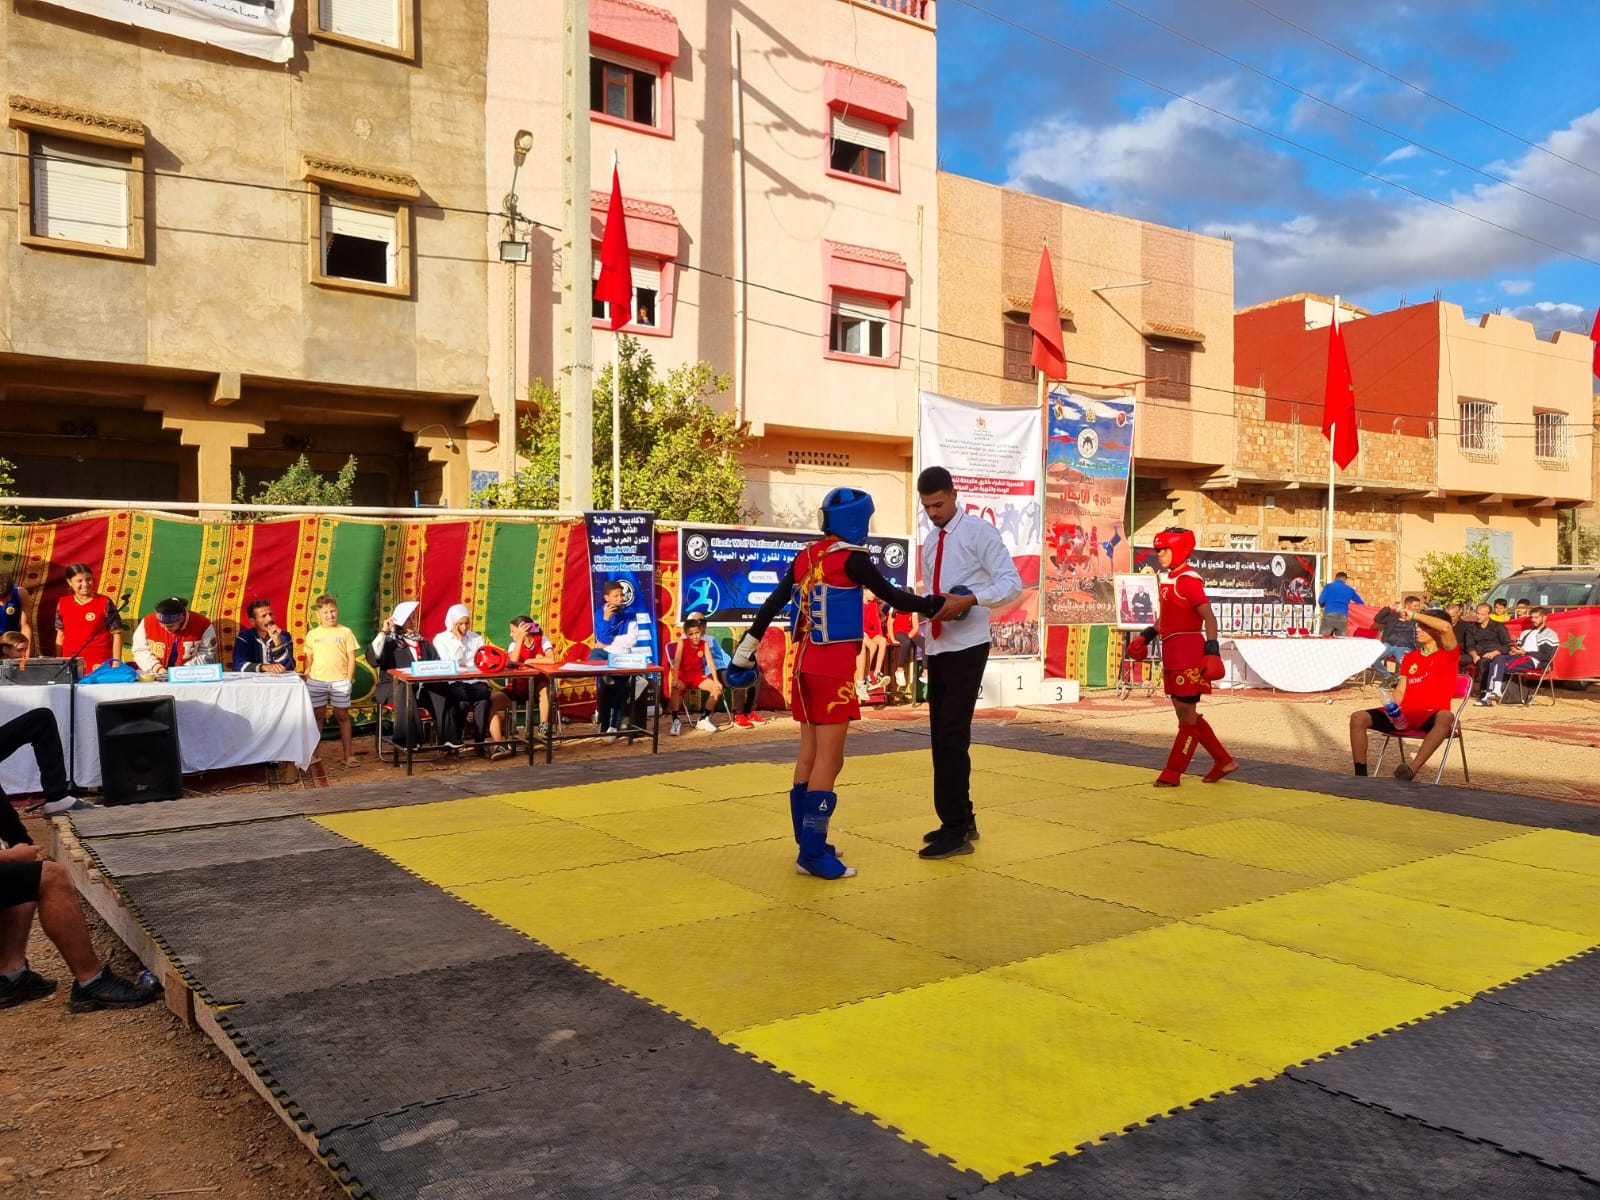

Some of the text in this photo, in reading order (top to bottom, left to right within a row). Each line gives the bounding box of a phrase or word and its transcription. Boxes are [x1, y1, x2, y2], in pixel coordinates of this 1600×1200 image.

[1060, 486, 1111, 506] دوري الأبطال
[592, 515, 646, 526] الأكاديمية الوطنية
[602, 525, 620, 535] الأسود
[591, 535, 650, 545] لفنون الحرب الصينية
[710, 537, 732, 548] Black
[732, 538, 749, 548] Wolf
[750, 538, 779, 549] National
[779, 540, 806, 550] Academ
[604, 545, 637, 554] Black Wolf
[593, 555, 647, 564] National Academy
[712, 550, 737, 562] الصينية
[739, 551, 759, 562] الحرب
[762, 553, 780, 563] لفنون
[1016, 675, 1023, 690] 1
[1055, 686, 1063, 701] 3
